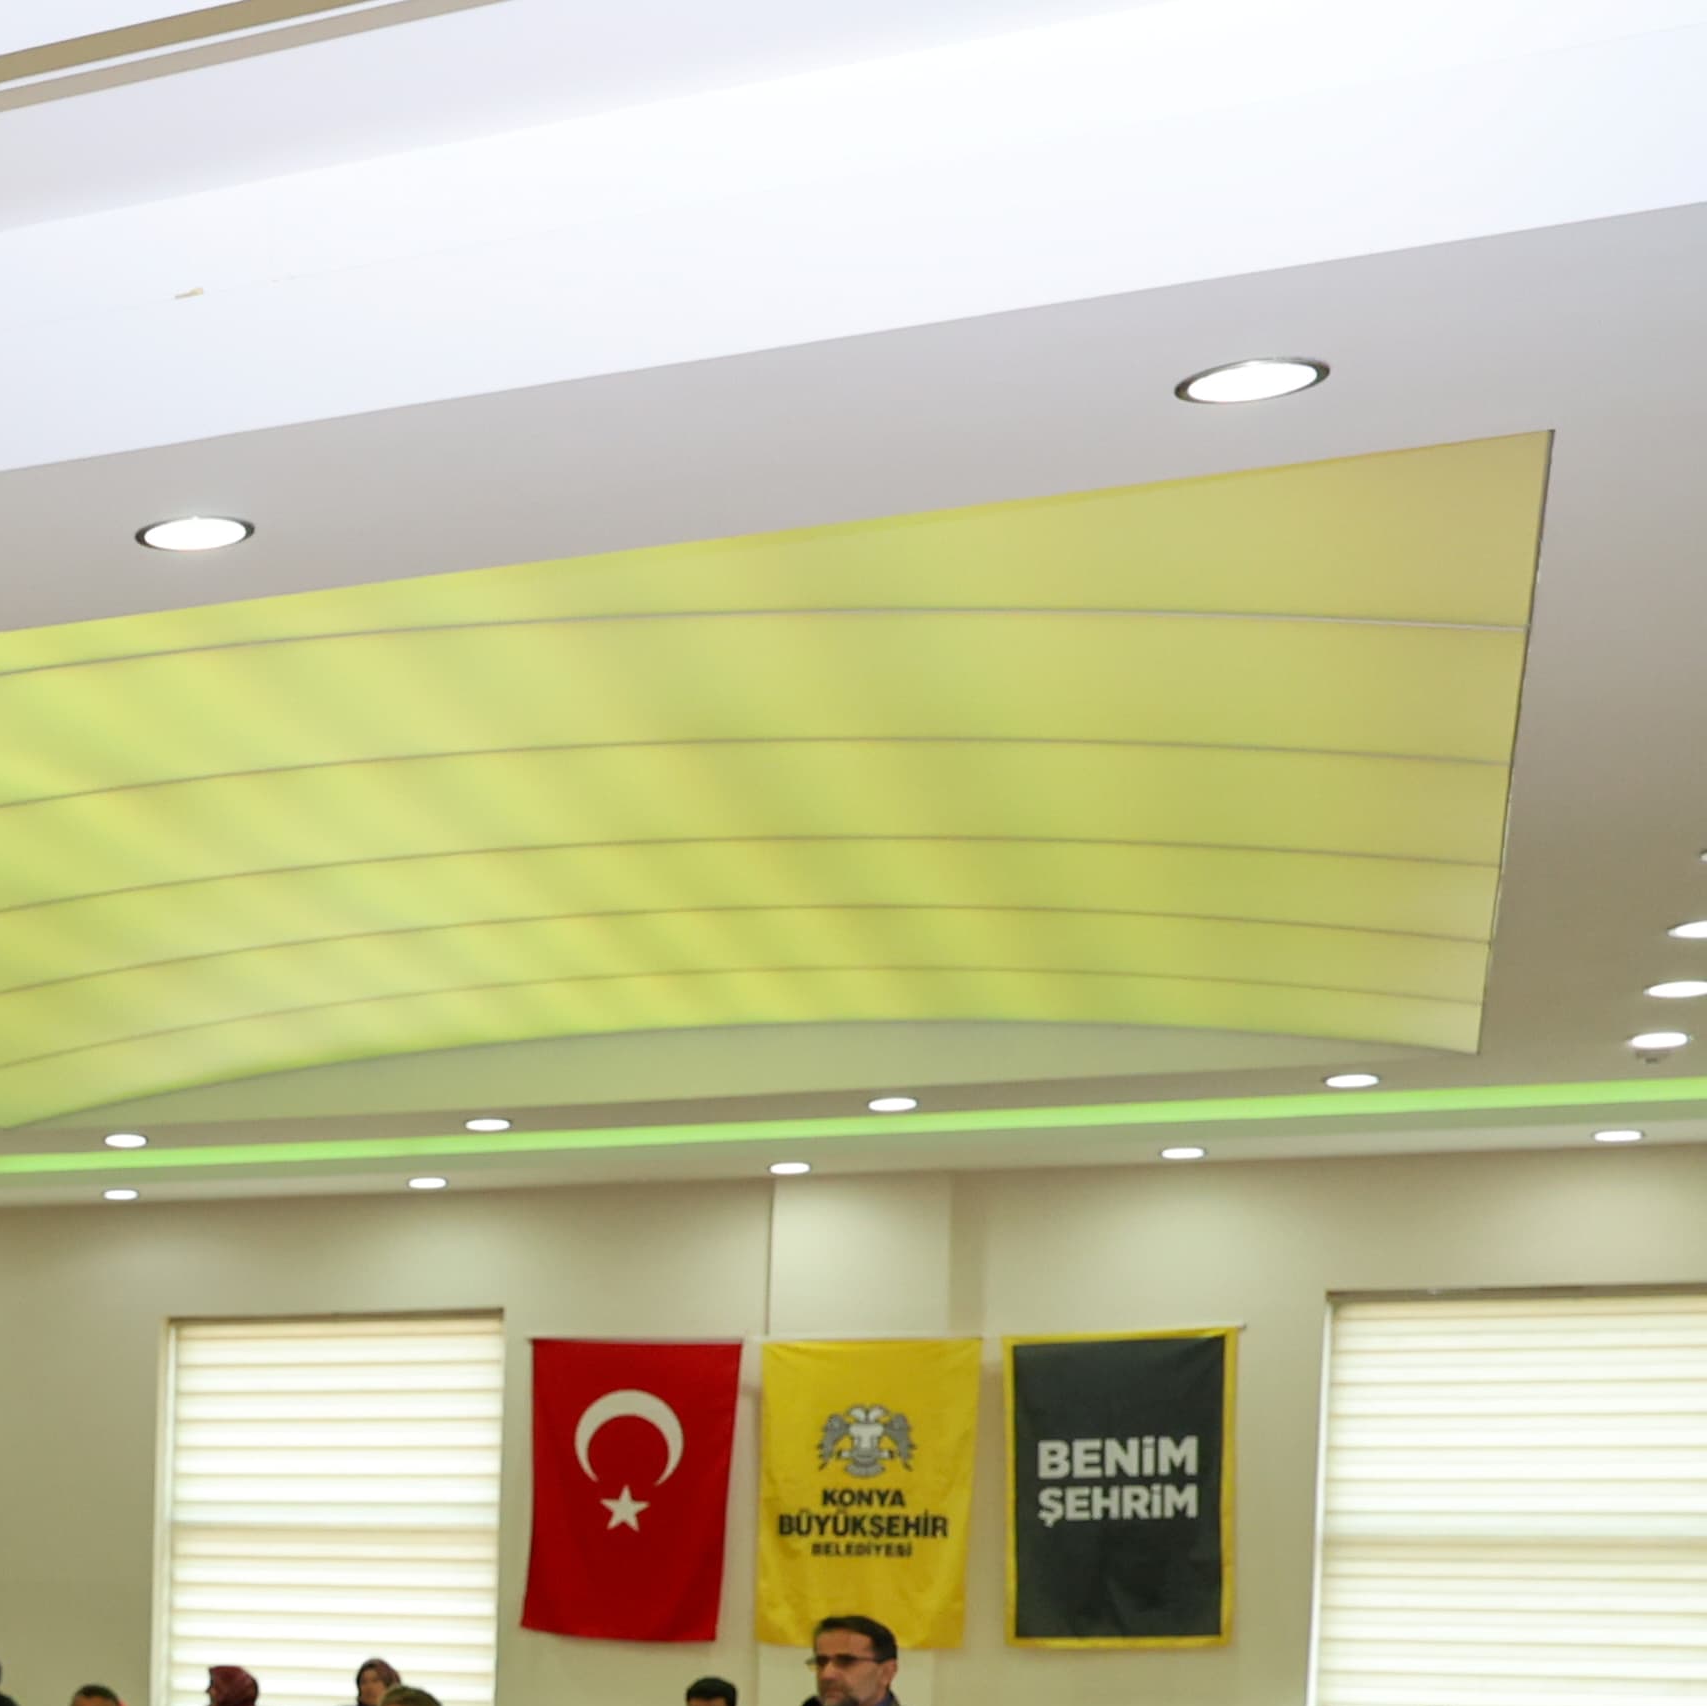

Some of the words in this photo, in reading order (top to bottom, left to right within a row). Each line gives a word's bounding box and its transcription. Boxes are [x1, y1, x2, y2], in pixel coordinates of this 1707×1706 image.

[1037, 1435, 1199, 1479] BENİM
[822, 1488, 906, 1507] KONYA
[1037, 1483, 1199, 1528] ŞEHRİM
[778, 1508, 949, 1539] BÜYÜKŞEHİR
